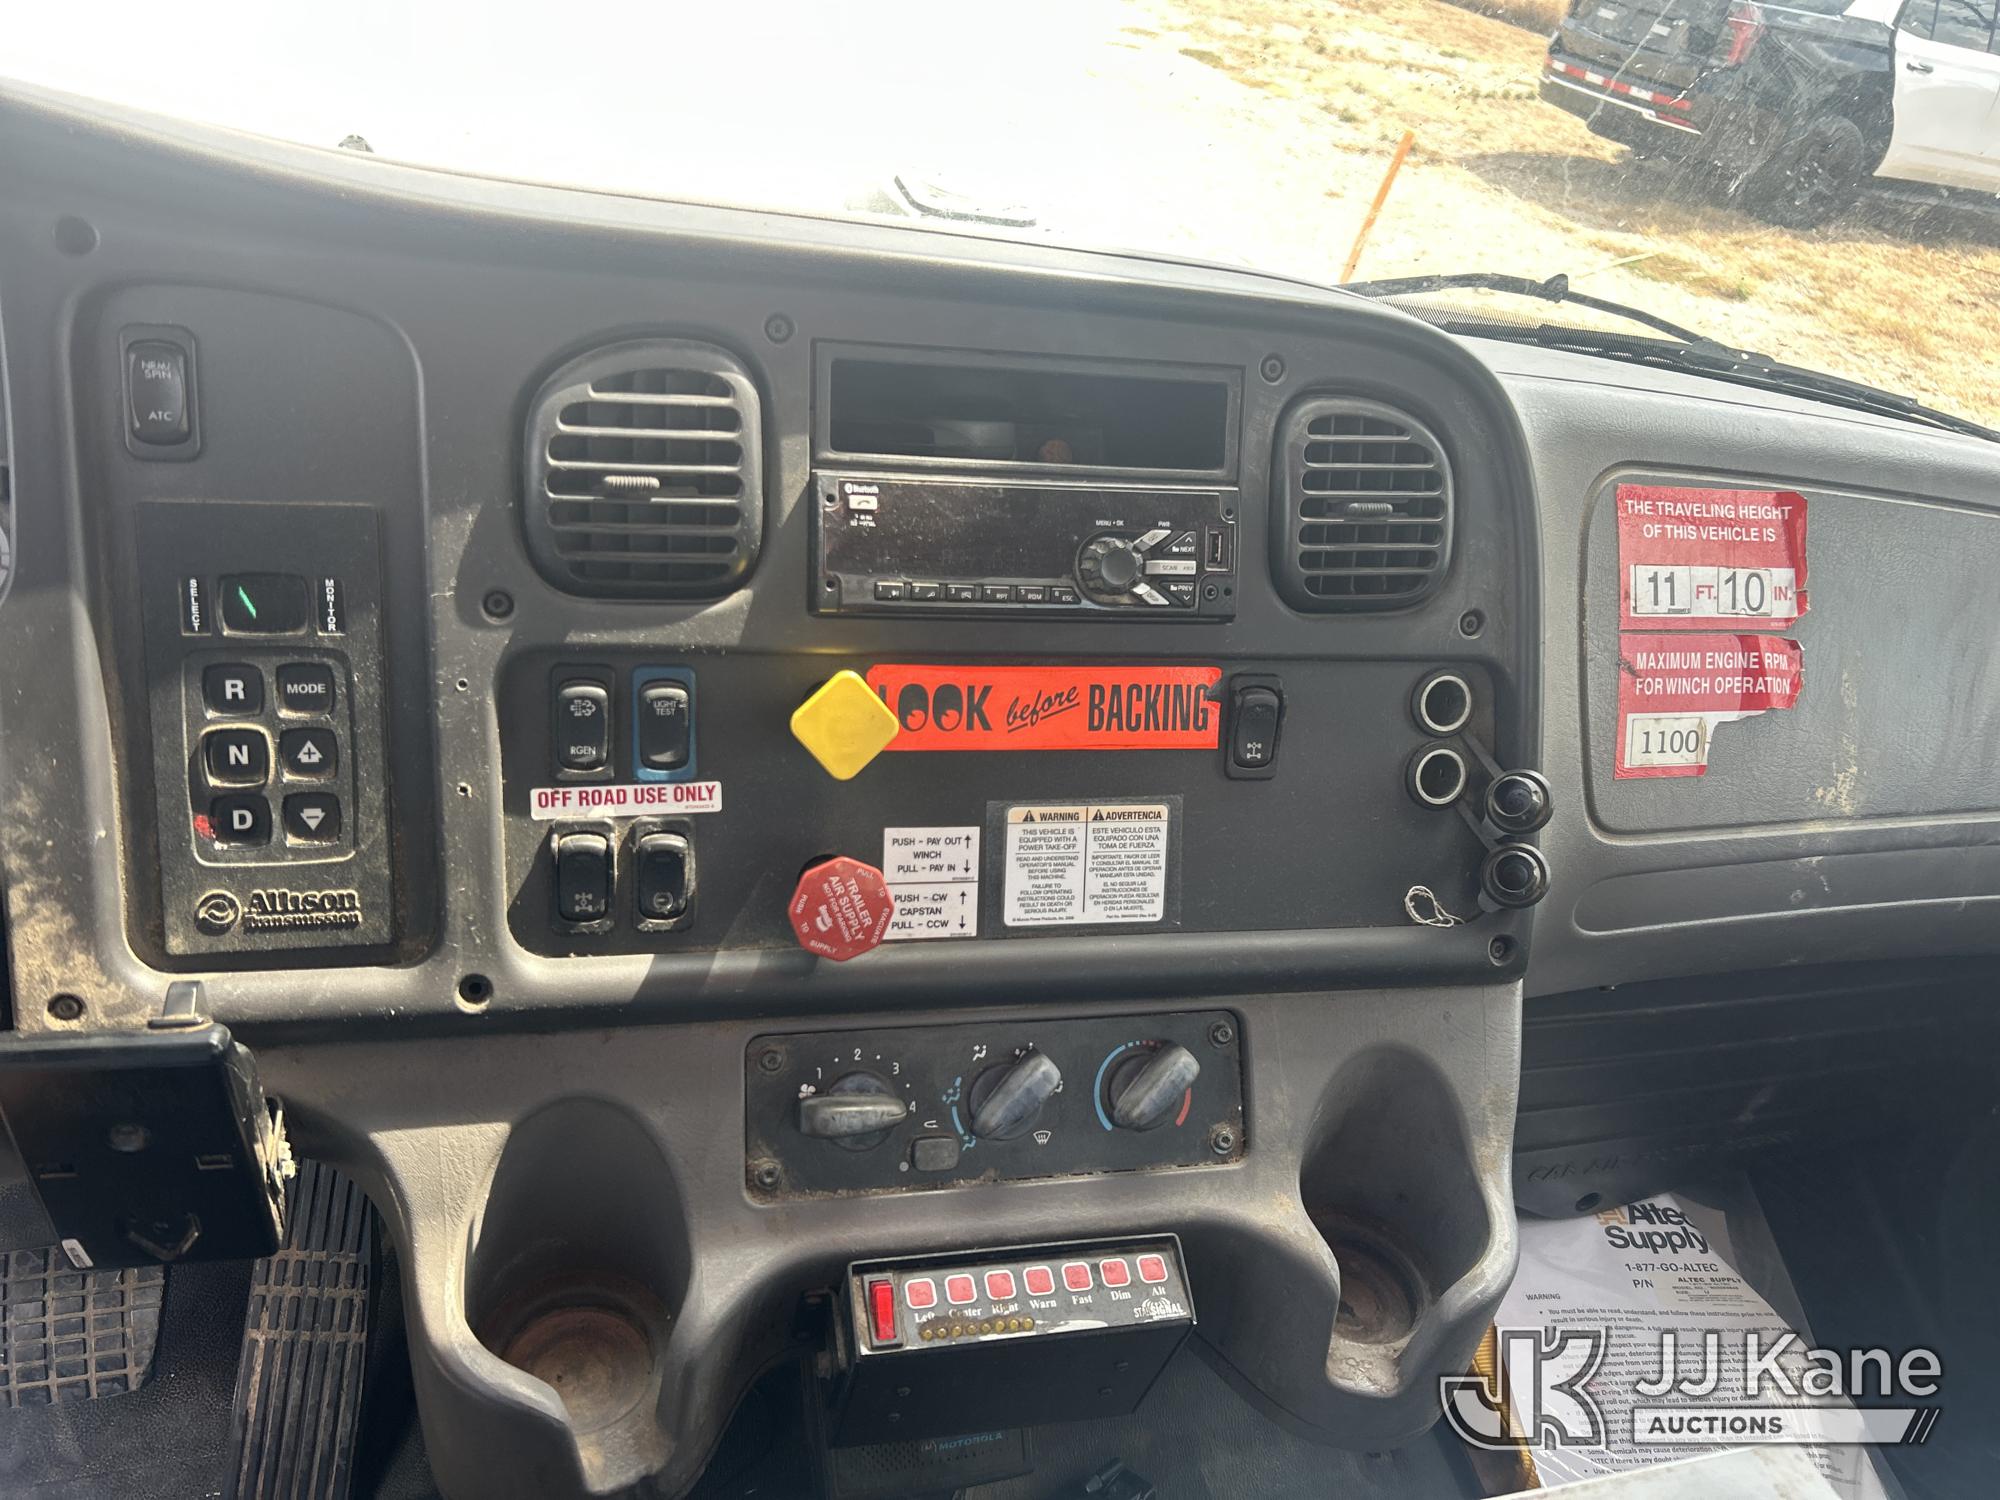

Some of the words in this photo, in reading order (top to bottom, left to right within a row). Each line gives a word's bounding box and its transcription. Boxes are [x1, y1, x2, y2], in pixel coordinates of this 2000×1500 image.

[144, 369, 172, 380] SPIN
[149, 411, 172, 421] ATC
[1625, 500, 1653, 515] THE
[1655, 502, 1735, 519] TRAVELING
[1739, 505, 1792, 520] HEIGHT
[1643, 524, 1663, 538] OF
[1664, 525, 1697, 540] THIS
[1700, 526, 1758, 542] VEHICLE
[1763, 529, 1776, 542] IS
[1648, 571, 1675, 606] 11
[1696, 585, 1717, 600] FT.
[1724, 570, 1765, 612] 10
[1774, 586, 1793, 601] IN.
[189, 579, 199, 631] SELECT
[325, 579, 336, 631] MONITOR
[1636, 652, 1701, 670] MAXIMUM
[1705, 652, 1760, 670] ENGINE
[1764, 652, 1789, 669] RPM
[225, 679, 245, 700] R
[287, 683, 326, 694] MODE
[1635, 679, 1663, 696] FOR
[1665, 677, 1710, 695] WINCH
[1714, 677, 1791, 694] OPERATION
[653, 700, 677, 709] LIGHT
[879, 683, 993, 732] OOK
[1007, 685, 1080, 728] before
[1088, 683, 1208, 733] BACKING
[656, 708, 675, 716] TEST
[1641, 729, 1700, 755] 1100
[228, 745, 249, 765] N
[570, 746, 596, 755] RGEN
[538, 790, 572, 808] OFF
[578, 788, 627, 806] ROAD
[633, 786, 668, 803] USE
[674, 784, 717, 802] ONLY
[232, 810, 253, 830] D
[1040, 812, 1080, 821] WARNING
[1106, 811, 1162, 820] ADVERTENCIA
[927, 837, 941, 845] PAY
[945, 837, 962, 845] OUT
[913, 851, 942, 859] WINCH
[857, 868, 874, 880] PULL
[897, 864, 918, 873] PULL
[929, 864, 944, 872] PAY
[948, 864, 956, 872] IN
[878, 887, 885, 897] TO
[894, 894, 919, 902] PUSH
[932, 893, 948, 901] CW
[245, 888, 361, 912] Allison
[795, 894, 808, 913] PUSH
[846, 877, 873, 928] TRAILER
[822, 882, 834, 897] NOT
[829, 897, 840, 913] FOR
[835, 912, 852, 943] PARKING
[829, 875, 845, 896] AIR
[839, 896, 866, 940] SUPPLY
[900, 907, 942, 916] CAPSTAN
[245, 911, 362, 930] Transmission
[870, 907, 890, 944] EVACUATE
[891, 920, 914, 928] PULL
[927, 920, 949, 928] CCW
[800, 922, 810, 933] TO
[809, 940, 838, 953] SUPPLY
[854, 1048, 861, 1061] 2
[816, 1067, 822, 1080] 1
[893, 1062, 900, 1075] 3
[909, 1100, 917, 1113] 4
[1605, 1226, 1709, 1254] Supply
[1625, 1263, 1718, 1273] 1-877-GO-ALTEC
[1633, 1279, 1654, 1289] P/N
[1110, 1290, 1131, 1301] Dim
[1152, 1286, 1166, 1296] Alt
[1526, 1293, 1561, 1301] WARNING
[1029, 1299, 1057, 1310] Warn
[1072, 1294, 1093, 1305] Fast
[939, 1432, 1003, 1450] MOTOROLA
